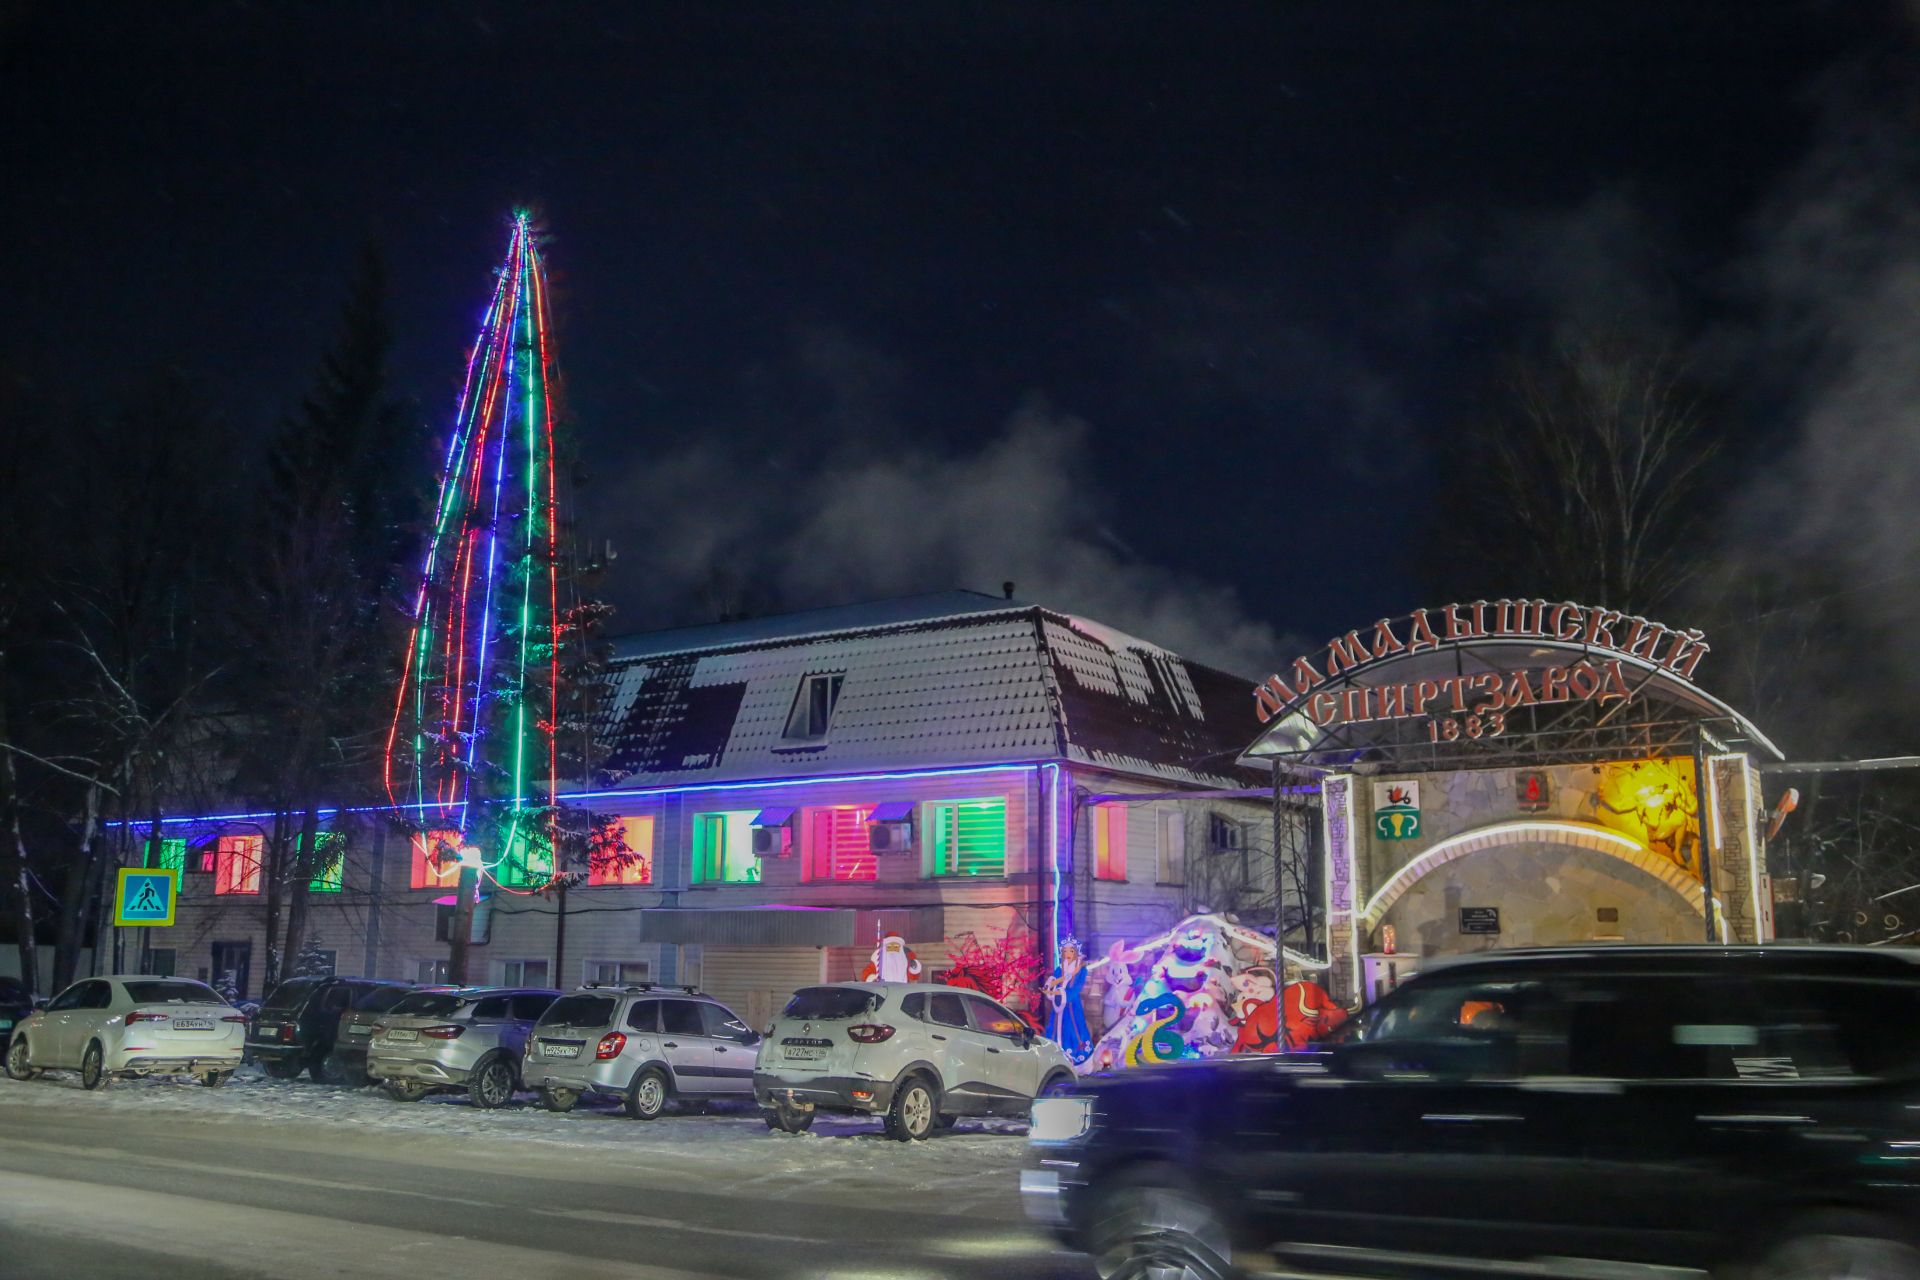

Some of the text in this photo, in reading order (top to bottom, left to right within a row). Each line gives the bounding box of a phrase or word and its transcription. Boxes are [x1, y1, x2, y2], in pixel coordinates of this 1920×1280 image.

[1253, 599, 1710, 723] МАМАДЫШСКИЙ
[1307, 659, 1632, 727] СПИРТЗАВОД
[1428, 713, 1504, 743] 1883
